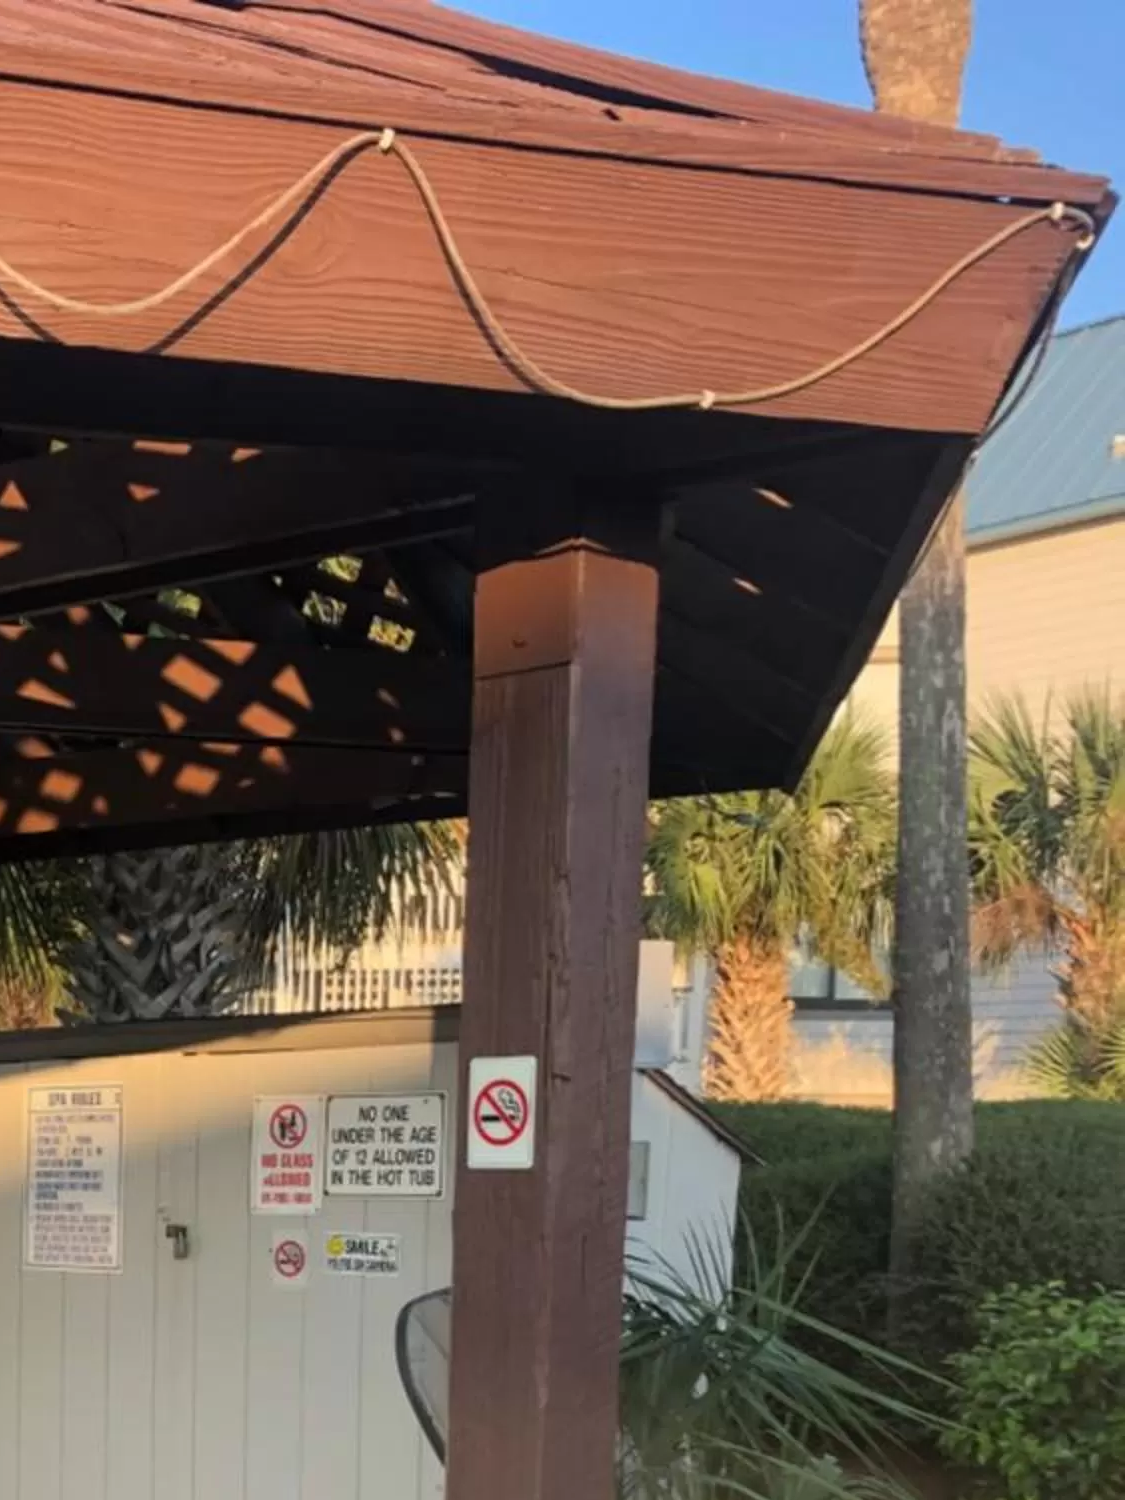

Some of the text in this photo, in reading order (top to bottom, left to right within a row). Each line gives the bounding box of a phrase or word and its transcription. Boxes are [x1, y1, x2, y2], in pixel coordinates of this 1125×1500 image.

[359, 1105, 410, 1122] NO ONE
[332, 1126, 437, 1144] UNDER THE AGE
[261, 1153, 314, 1168] NO GLASS
[332, 1149, 435, 1165] OF 12 ALLOWED
[263, 1172, 312, 1187] ALLOWED
[331, 1170, 435, 1186] IN THE HOT TUB
